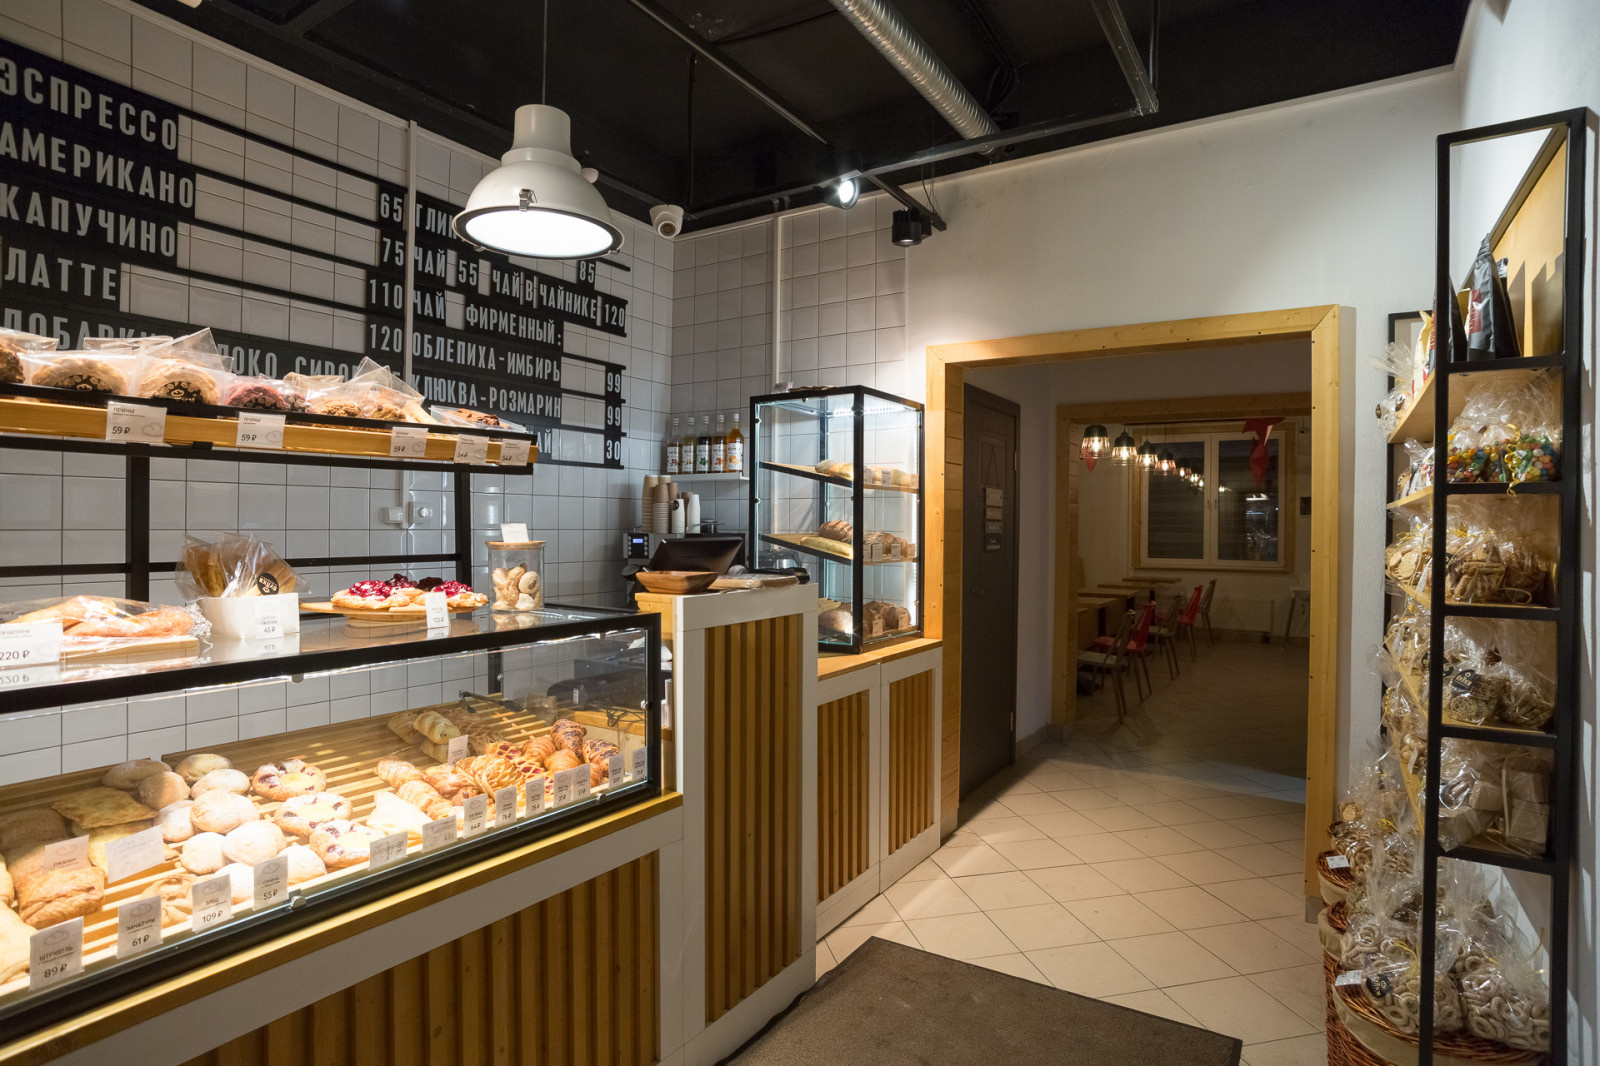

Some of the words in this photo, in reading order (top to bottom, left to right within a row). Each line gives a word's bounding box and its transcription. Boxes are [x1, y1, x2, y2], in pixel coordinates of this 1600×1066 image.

[0, 57, 177, 150] ЭСПРЕССО
[380, 192, 403, 223] 65
[0, 121, 194, 208] АМЕРИКАНО
[382, 237, 404, 266] 75
[0, 182, 176, 257] КАПУЧИНО
[369, 279, 403, 310] 110
[579, 260, 595, 283] 85
[414, 246, 446, 278] ЧАЙ
[458, 259, 478, 286] 55
[493, 270, 520, 298] ЧАЙ
[525, 279, 534, 302] В
[539, 283, 597, 319] ЧАЙНИКЕ
[604, 303, 625, 327] 120
[4, 247, 117, 301] ЛАТТЕ
[369, 323, 403, 353] 120
[413, 290, 446, 320] ЧАЙ
[607, 372, 621, 393] 99
[606, 405, 621, 427] 99
[112, 426, 122, 435] 59
[241, 433, 250, 441] 59
[606, 439, 621, 461] 30
[263, 890, 272, 901] 55
[202, 912, 216, 922] 109
[132, 936, 142, 947] 61
[39, 945, 73, 961] ШТРУДЕЛЬ
[44, 966, 58, 978] 89
